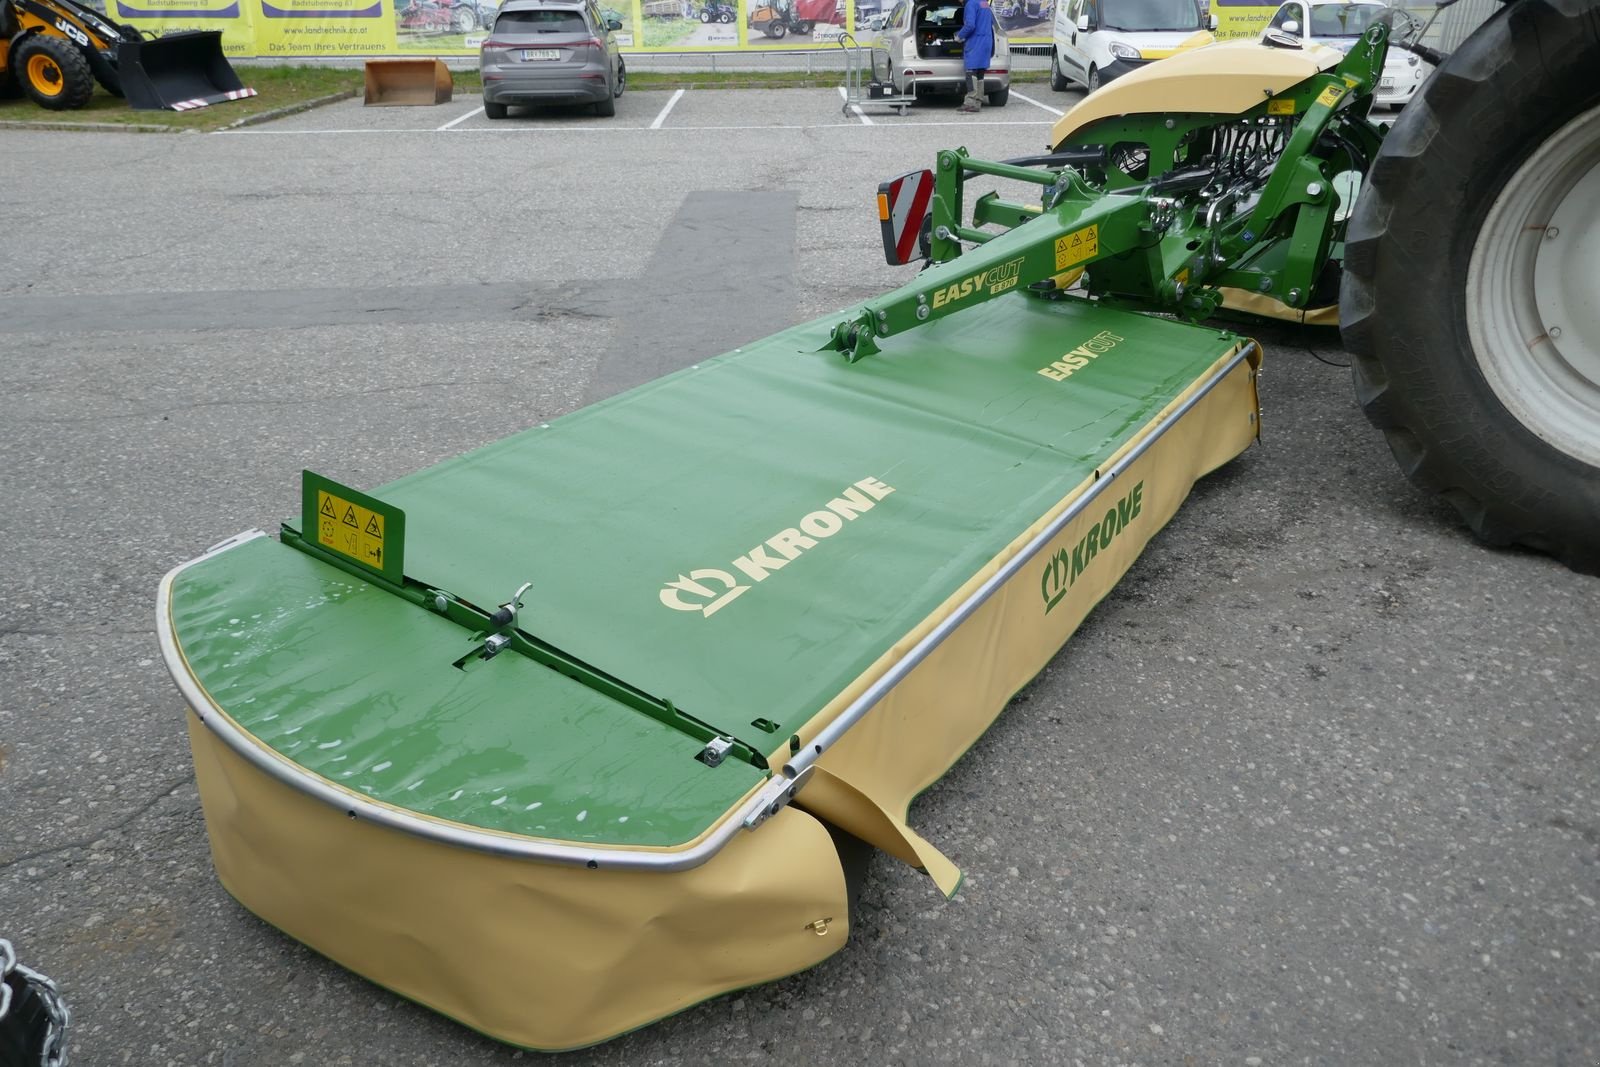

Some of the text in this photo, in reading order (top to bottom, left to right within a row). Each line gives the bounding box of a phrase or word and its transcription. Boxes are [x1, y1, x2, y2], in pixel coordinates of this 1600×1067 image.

[55, 17, 89, 47] JCB
[269, 43, 386, 51] Das Team Ihres Vertrauens
[283, 25, 368, 34] www.landtechnik.co.at
[1213, 29, 1226, 38] Das
[1229, 29, 1249, 38] Team
[932, 256, 1025, 309] EASYCUT
[1037, 330, 1125, 382] EASYCUT
[732, 476, 897, 582] KRONE
[1068, 480, 1144, 586] KRONE
